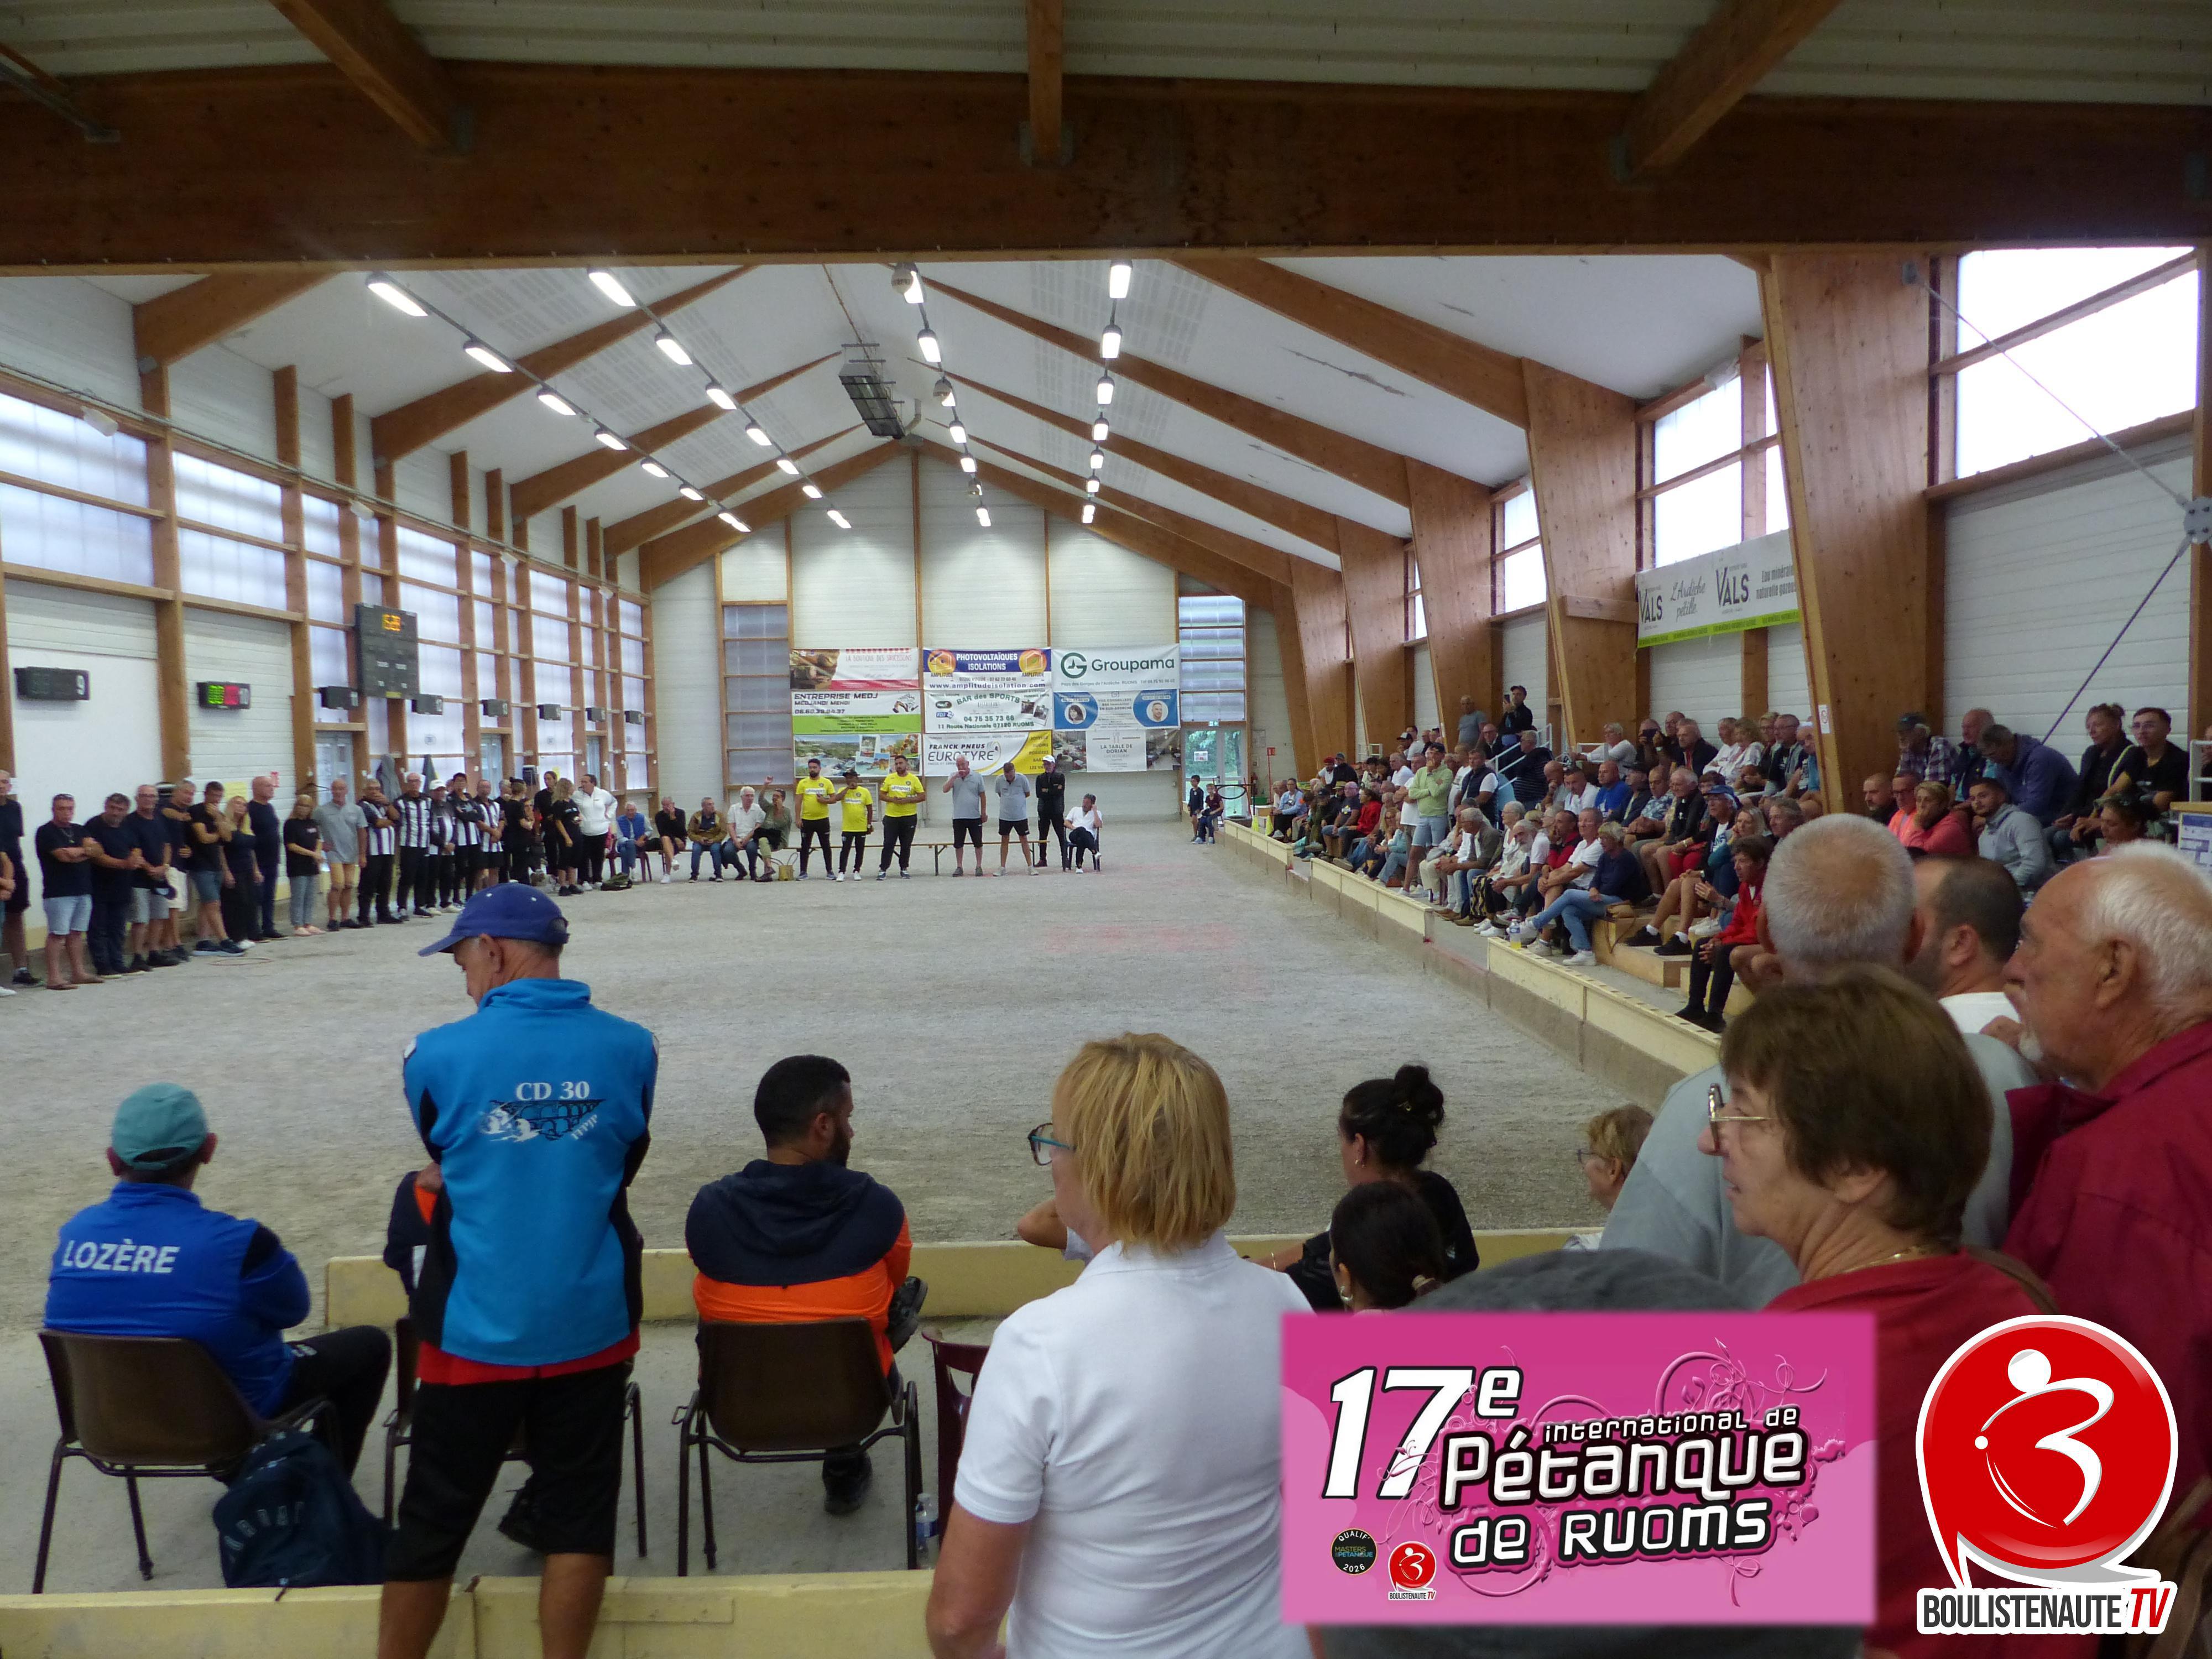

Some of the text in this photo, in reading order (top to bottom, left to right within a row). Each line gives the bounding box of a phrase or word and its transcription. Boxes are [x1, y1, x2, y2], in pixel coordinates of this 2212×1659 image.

[1715, 566, 1750, 606] VALS
[1638, 589, 1662, 623] VALS
[956, 651, 1018, 661] PHOTOVOLTAÏQUES
[1092, 659, 1175, 673] Groupama
[956, 695, 972, 705] BAR
[989, 692, 1020, 704] SPORTS
[515, 1081, 590, 1102] CD 30
[61, 1238, 181, 1274] LOZÈRE
